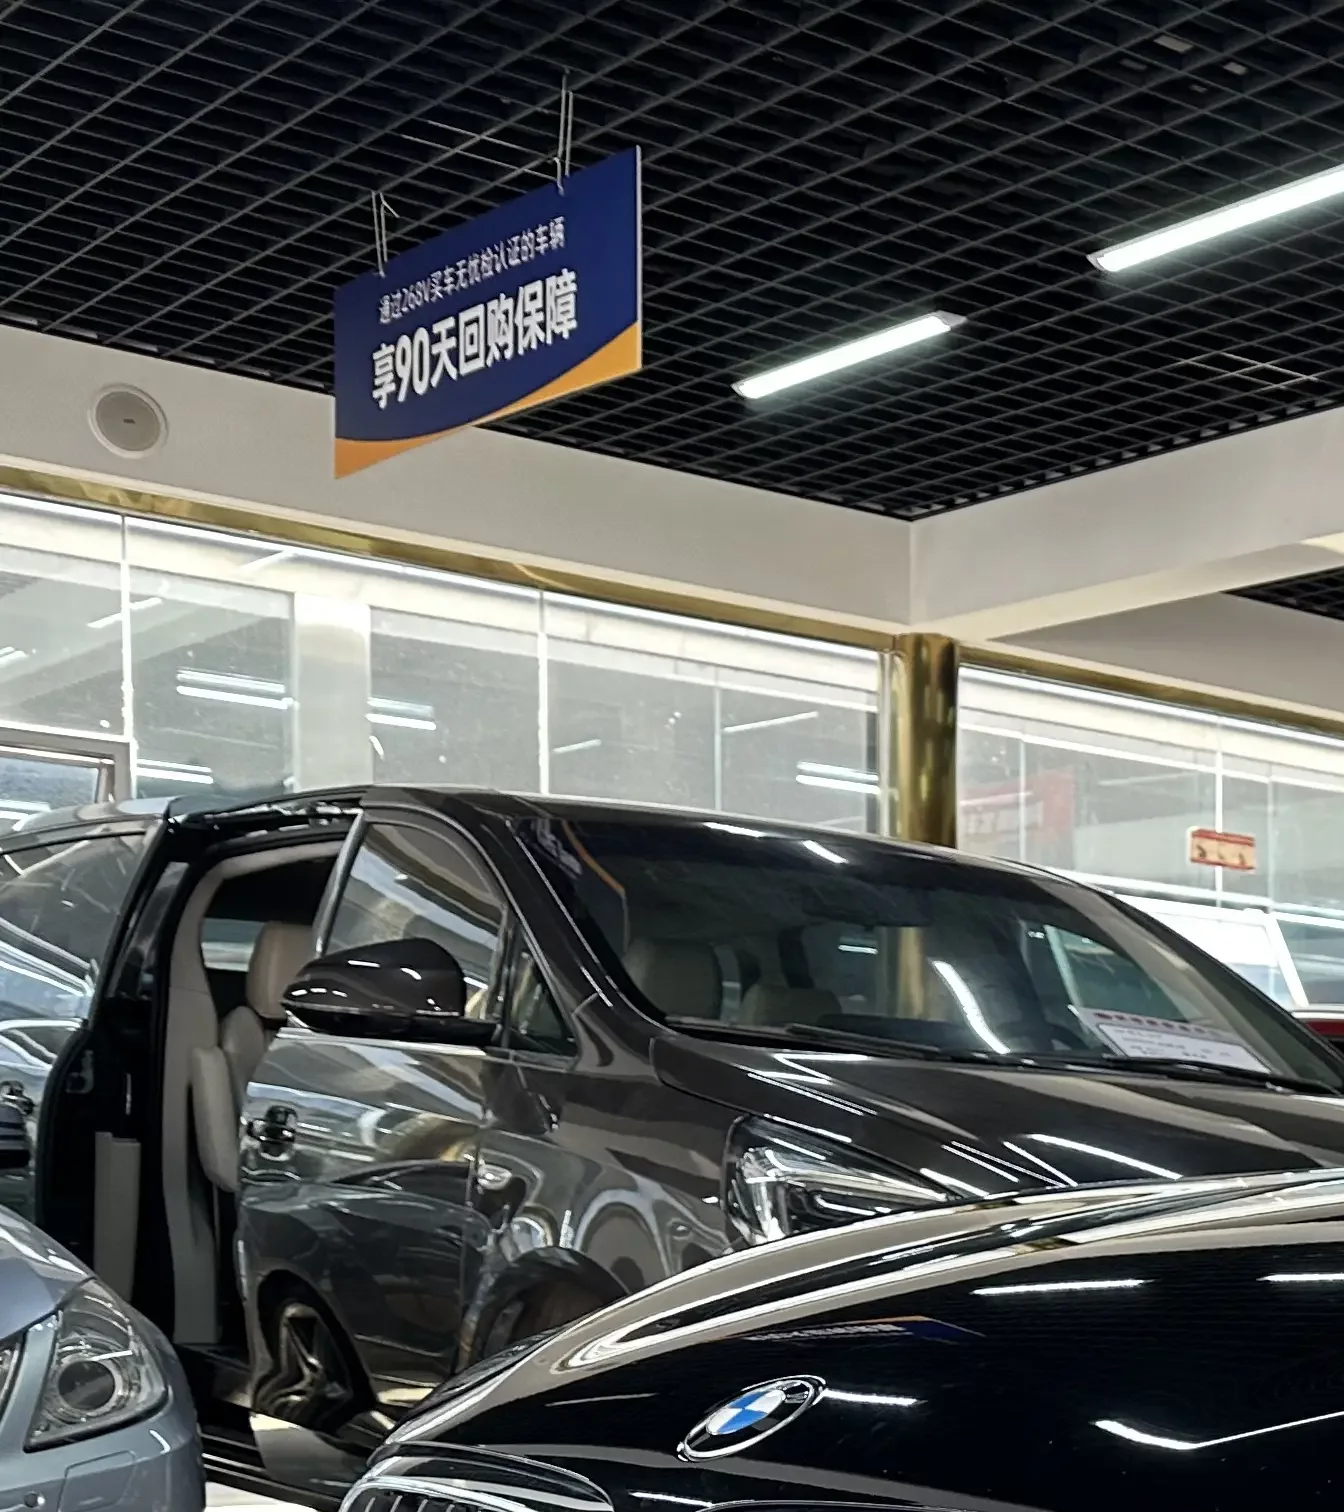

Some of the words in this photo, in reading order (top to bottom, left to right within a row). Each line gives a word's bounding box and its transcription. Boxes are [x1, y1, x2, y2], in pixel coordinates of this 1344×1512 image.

[371, 267, 578, 410] 享90天回购保障
